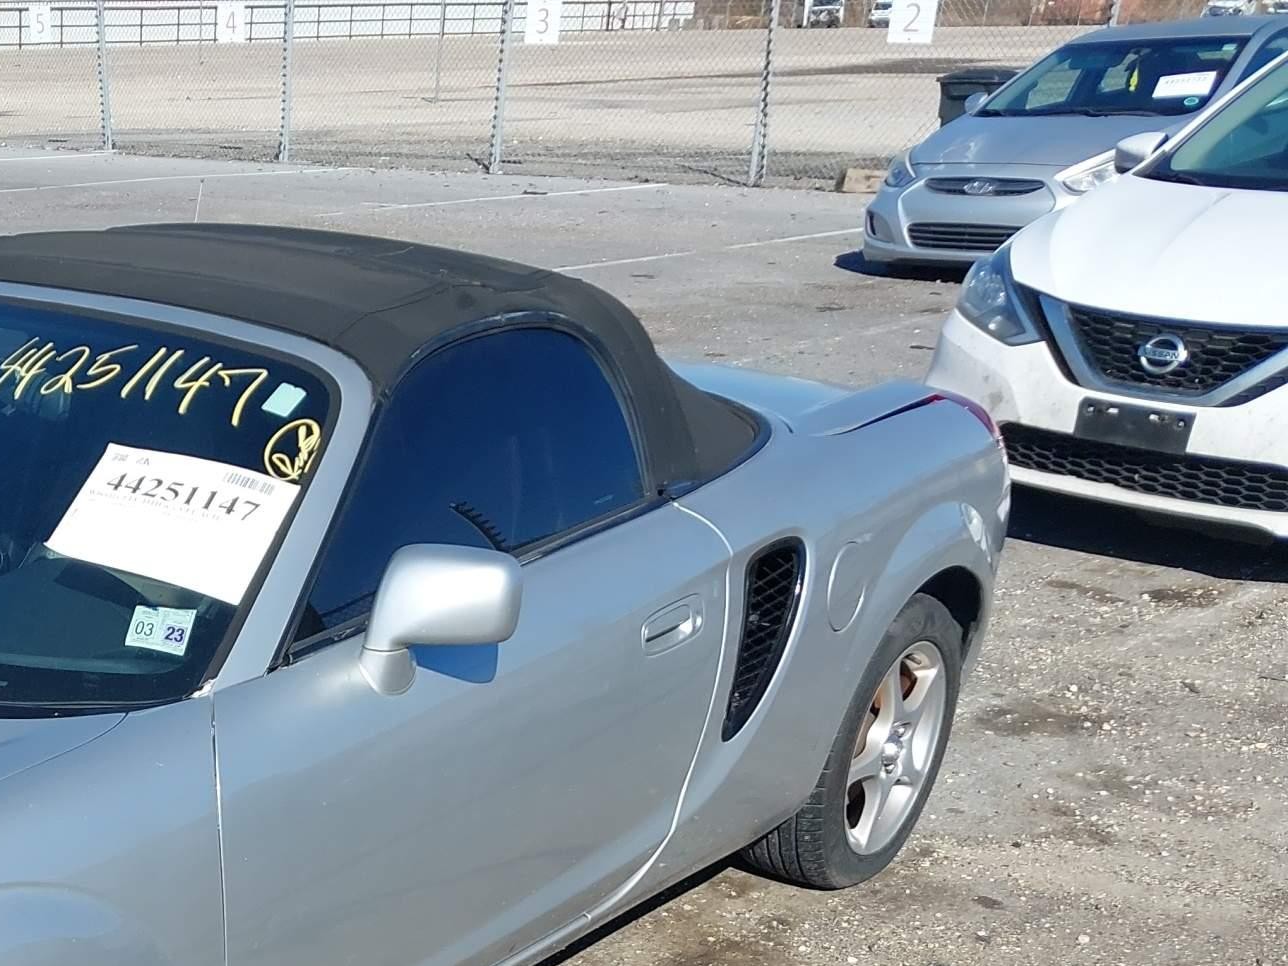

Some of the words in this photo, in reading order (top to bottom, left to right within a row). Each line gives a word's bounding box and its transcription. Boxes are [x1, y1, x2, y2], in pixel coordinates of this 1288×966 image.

[35, 13, 45, 34] 5
[225, 10, 237, 34] 4
[536, 8, 549, 34] 3
[902, 2, 921, 32] 2
[106, 472, 261, 521] 44251147
[134, 620, 155, 637] 03
[164, 626, 185, 643] 23
